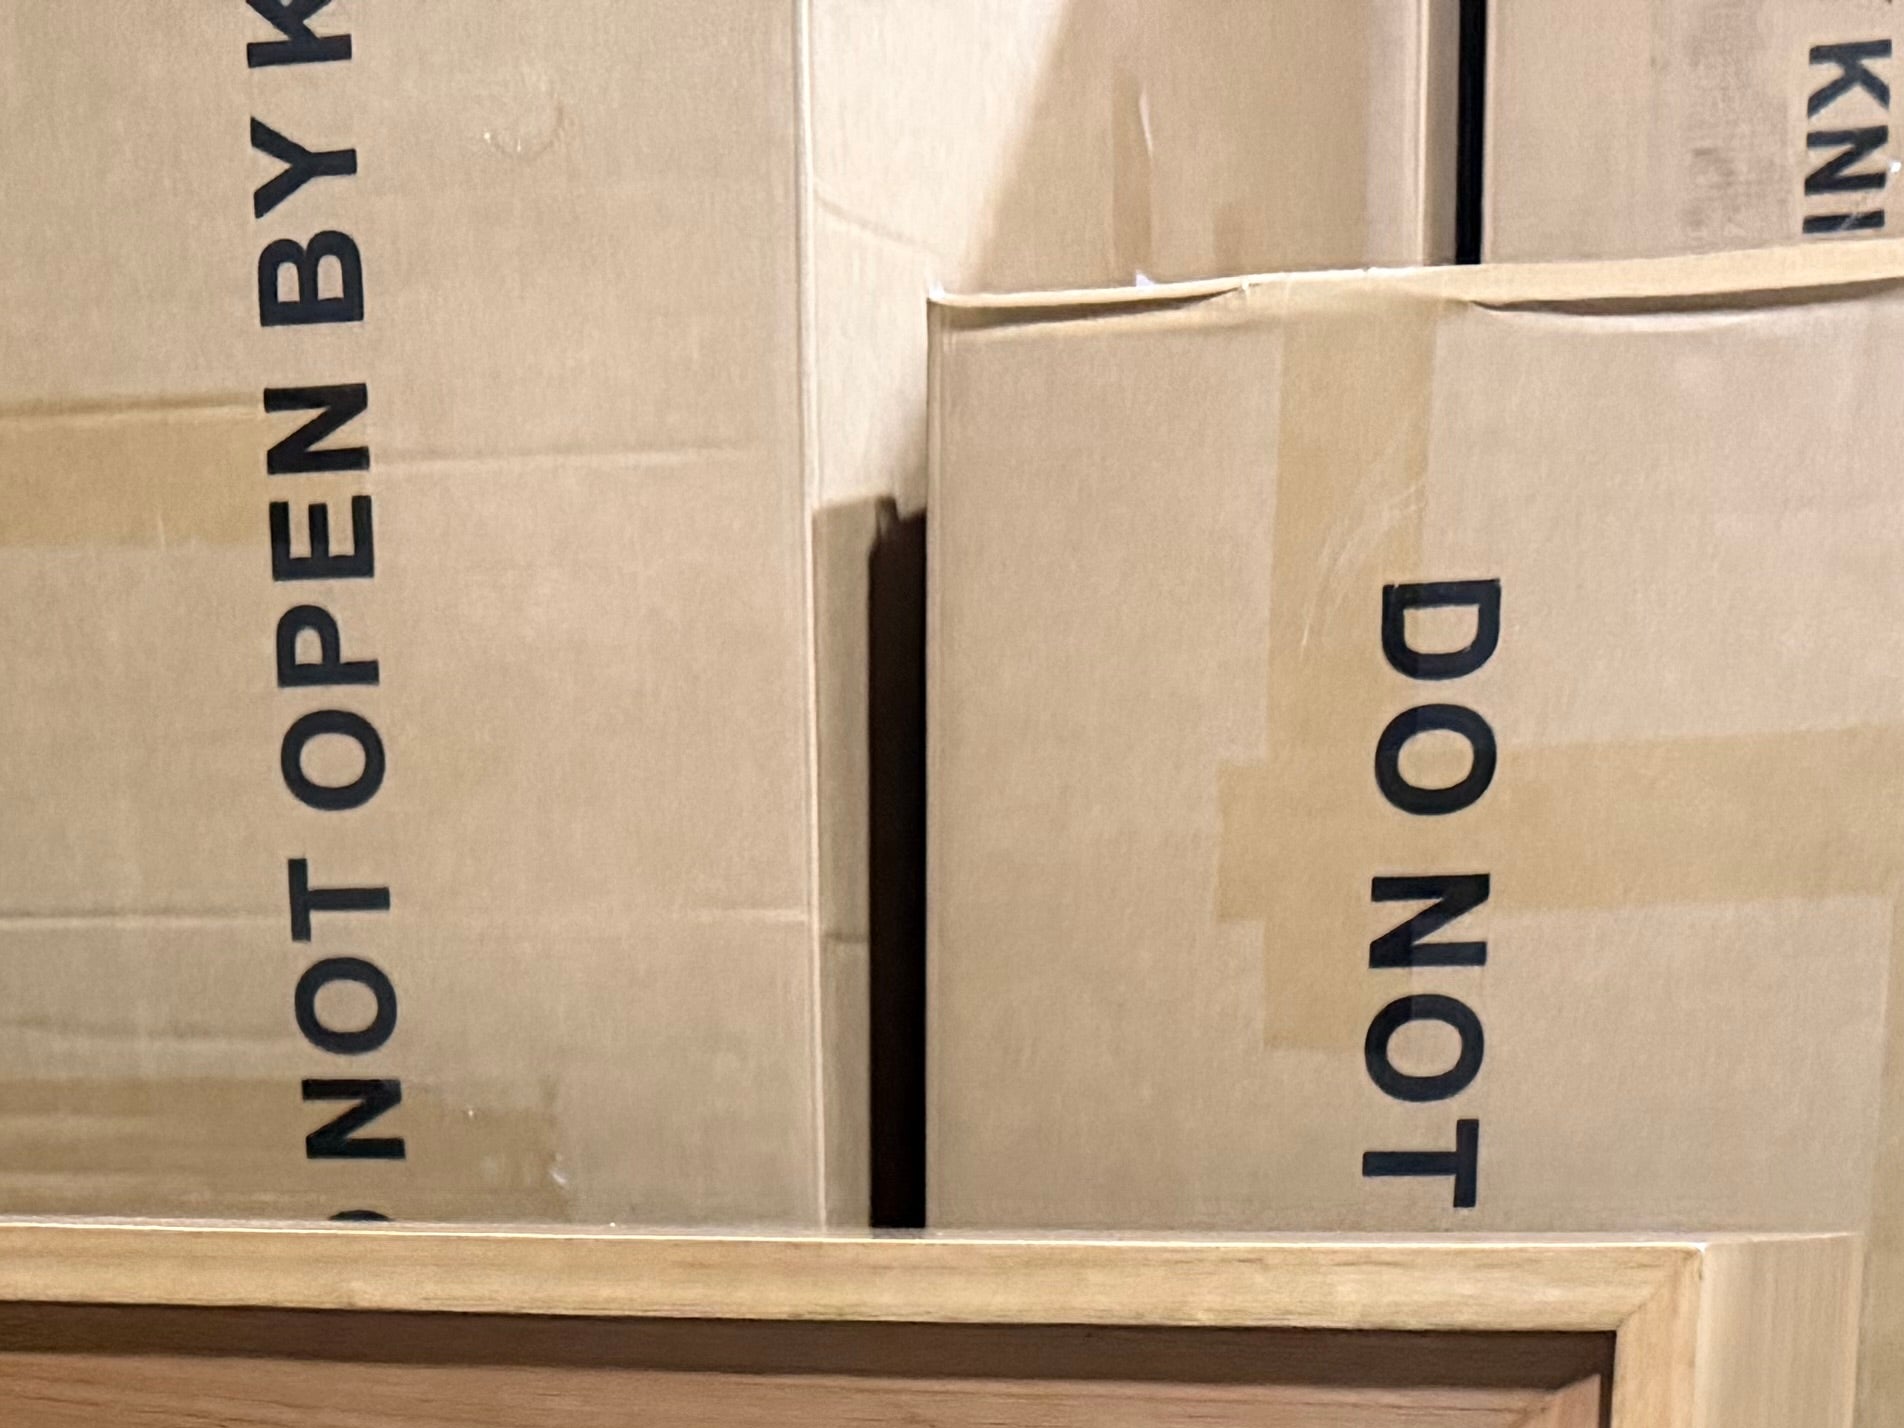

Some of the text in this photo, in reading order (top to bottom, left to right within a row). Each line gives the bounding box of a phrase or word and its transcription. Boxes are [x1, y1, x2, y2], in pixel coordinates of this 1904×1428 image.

[250, 117, 364, 327] BY
[1802, 38, 1892, 234] KNI
[263, 383, 386, 811] OPEN
[287, 858, 406, 1160] NOT
[1361, 578, 1502, 1209] DO NOT
